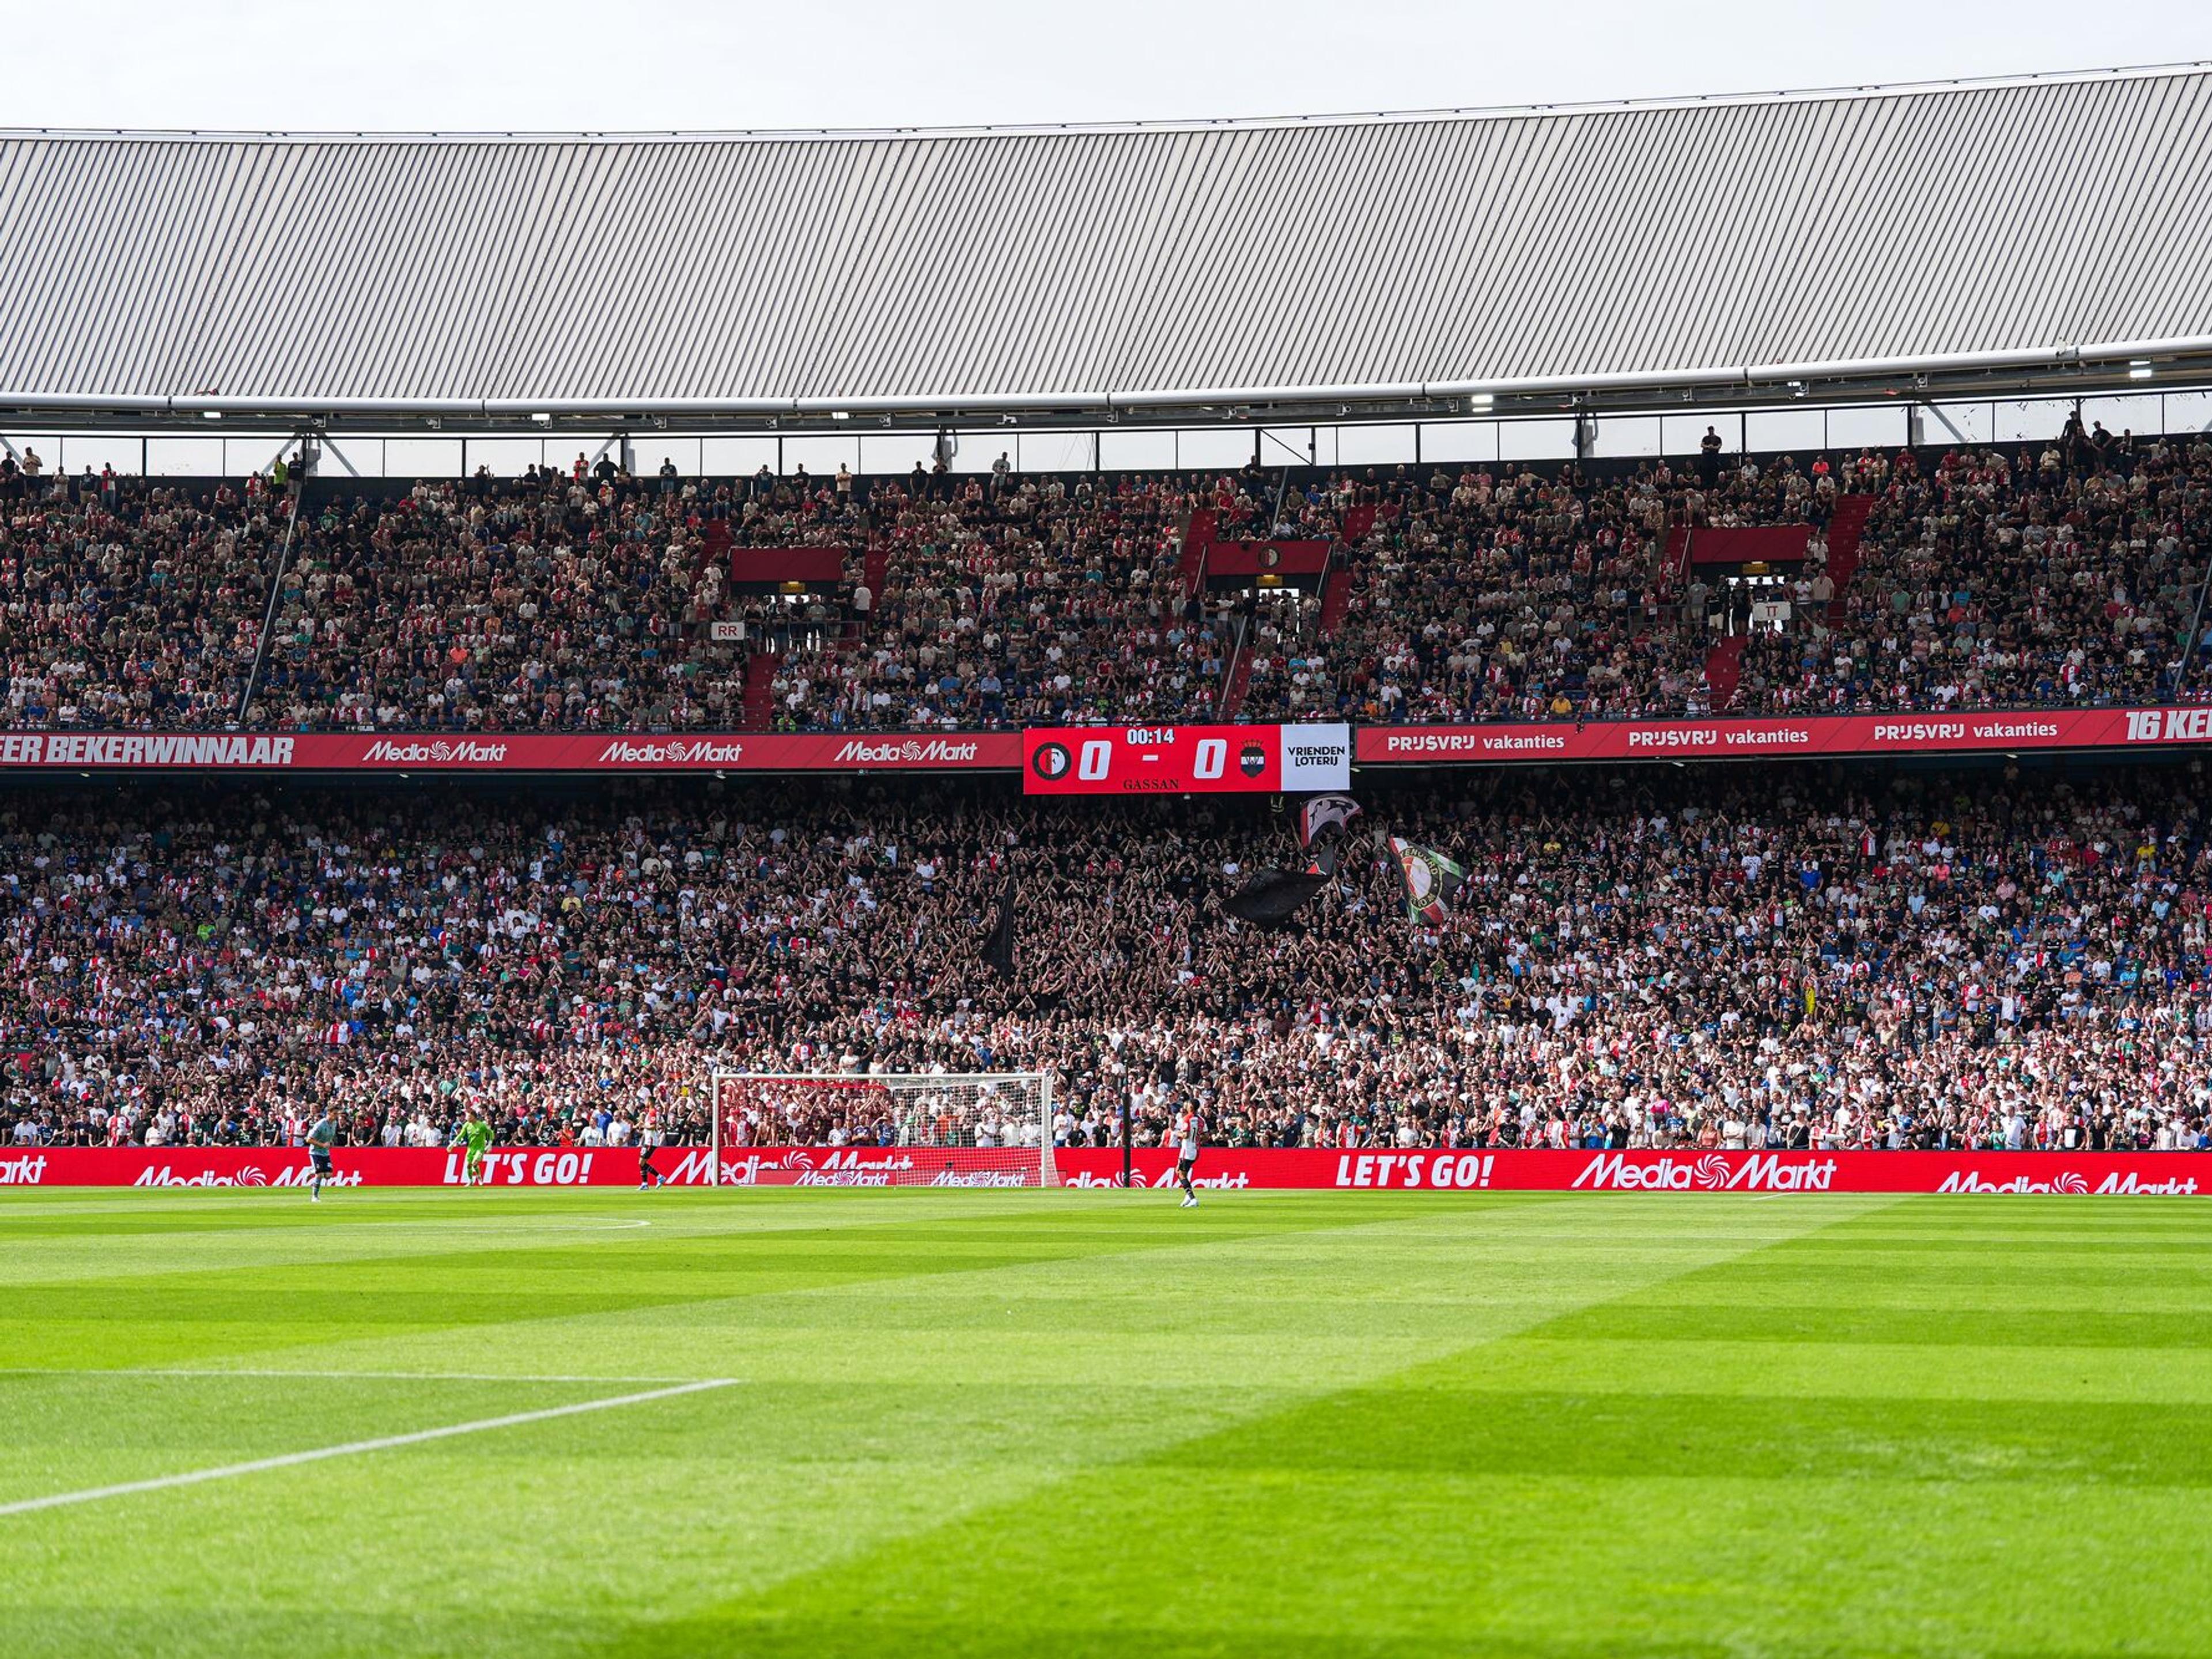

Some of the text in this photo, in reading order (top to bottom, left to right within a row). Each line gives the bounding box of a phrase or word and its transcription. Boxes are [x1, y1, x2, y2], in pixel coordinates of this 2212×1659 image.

[718, 626, 738, 637] RR
[1973, 722, 2058, 738] vakanties
[2126, 710, 2161, 740] 16
[1126, 729, 1174, 744] 00:14
[1483, 734, 1564, 749] vakanties
[1726, 729, 1808, 744] vakanties
[44, 736, 294, 763] BEKERWINNAAR
[362, 741, 507, 761] Media Markt
[599, 741, 742, 762] Media Markt
[834, 741, 977, 761] Media Markt
[1288, 746, 1345, 756] VRIENDEN
[1079, 741, 1111, 780] 0
[1194, 739, 1227, 778] 0
[1295, 756, 1338, 767] LOTERIJ
[1123, 778, 1179, 790] GASSAN
[272, 1166, 362, 1185] Mkt
[534, 1153, 593, 1183] GO!
[1336, 1155, 1494, 1187] LET'S GO!
[1571, 1154, 1837, 1189] Media Markt
